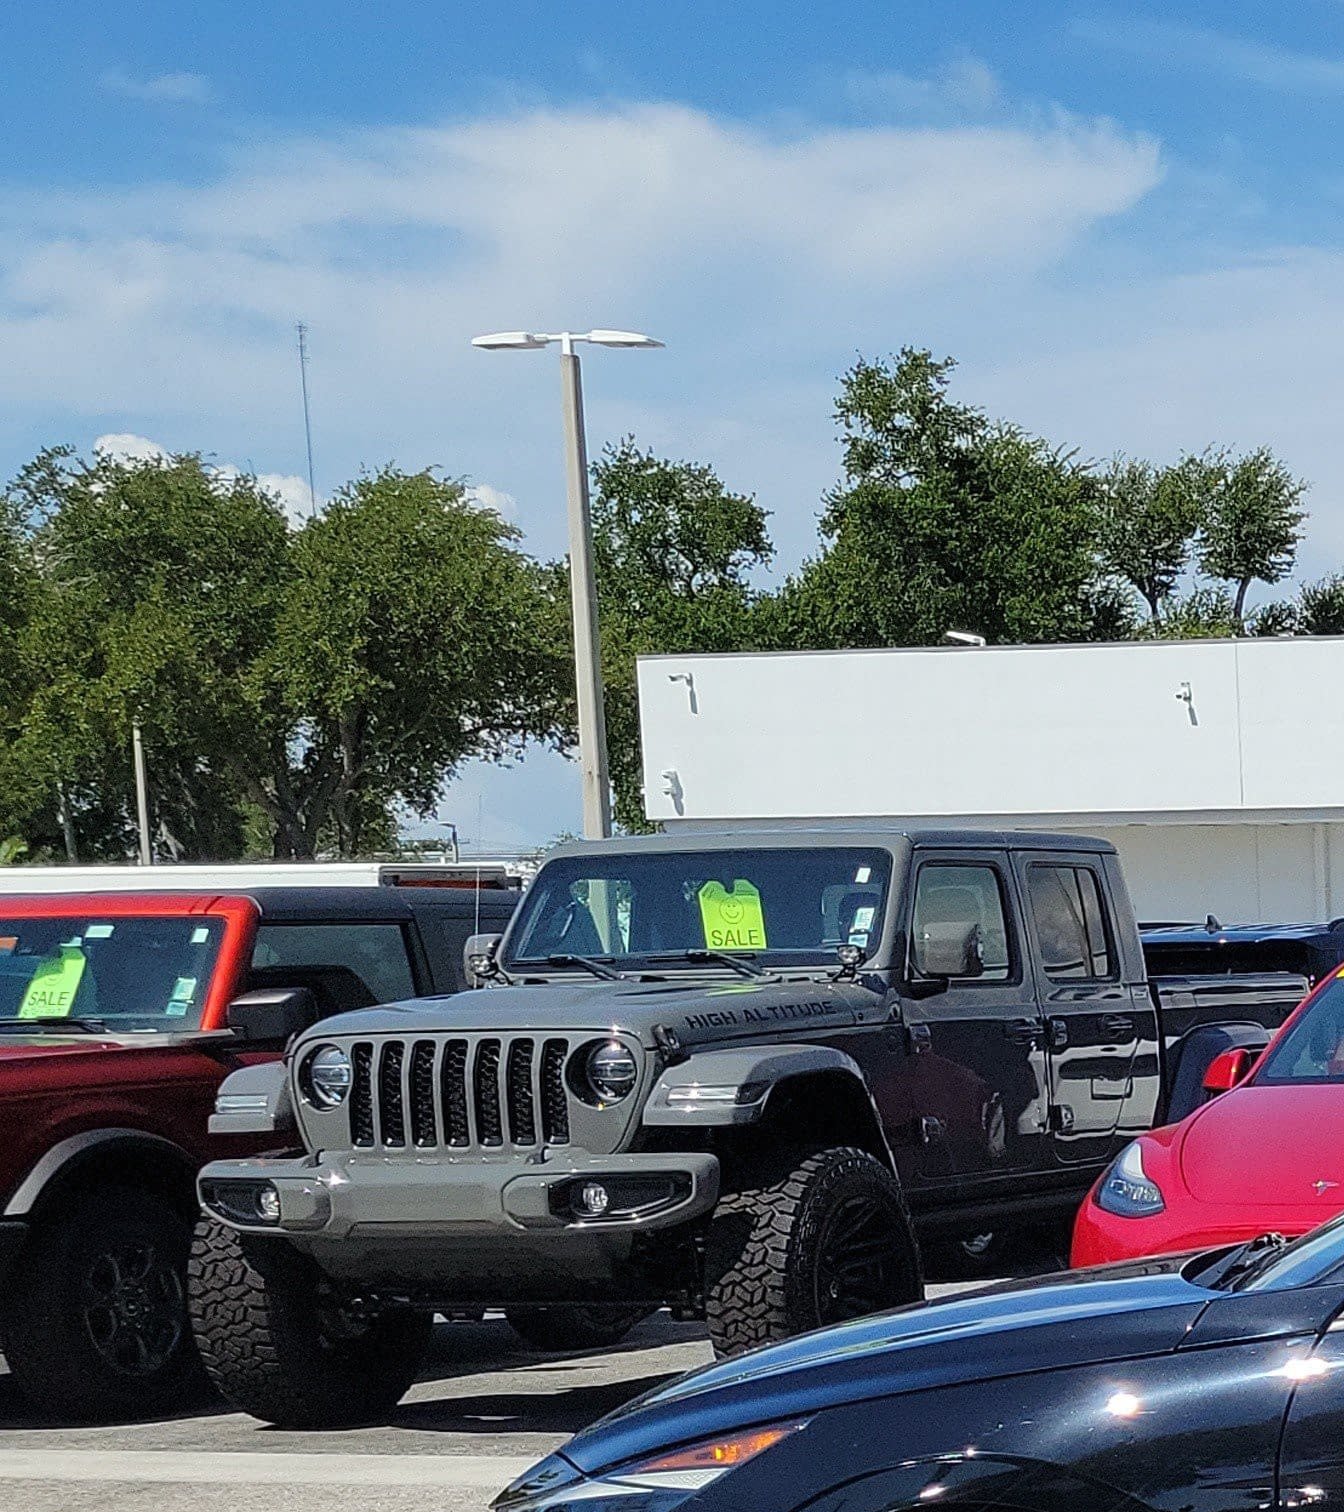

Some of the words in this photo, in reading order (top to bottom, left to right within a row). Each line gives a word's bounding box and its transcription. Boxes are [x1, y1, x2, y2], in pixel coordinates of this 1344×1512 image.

[711, 929, 761, 947] SALE
[28, 991, 70, 1006] SALE
[685, 1011, 737, 1029] HIGH
[742, 1001, 837, 1023] ALTITUDE
